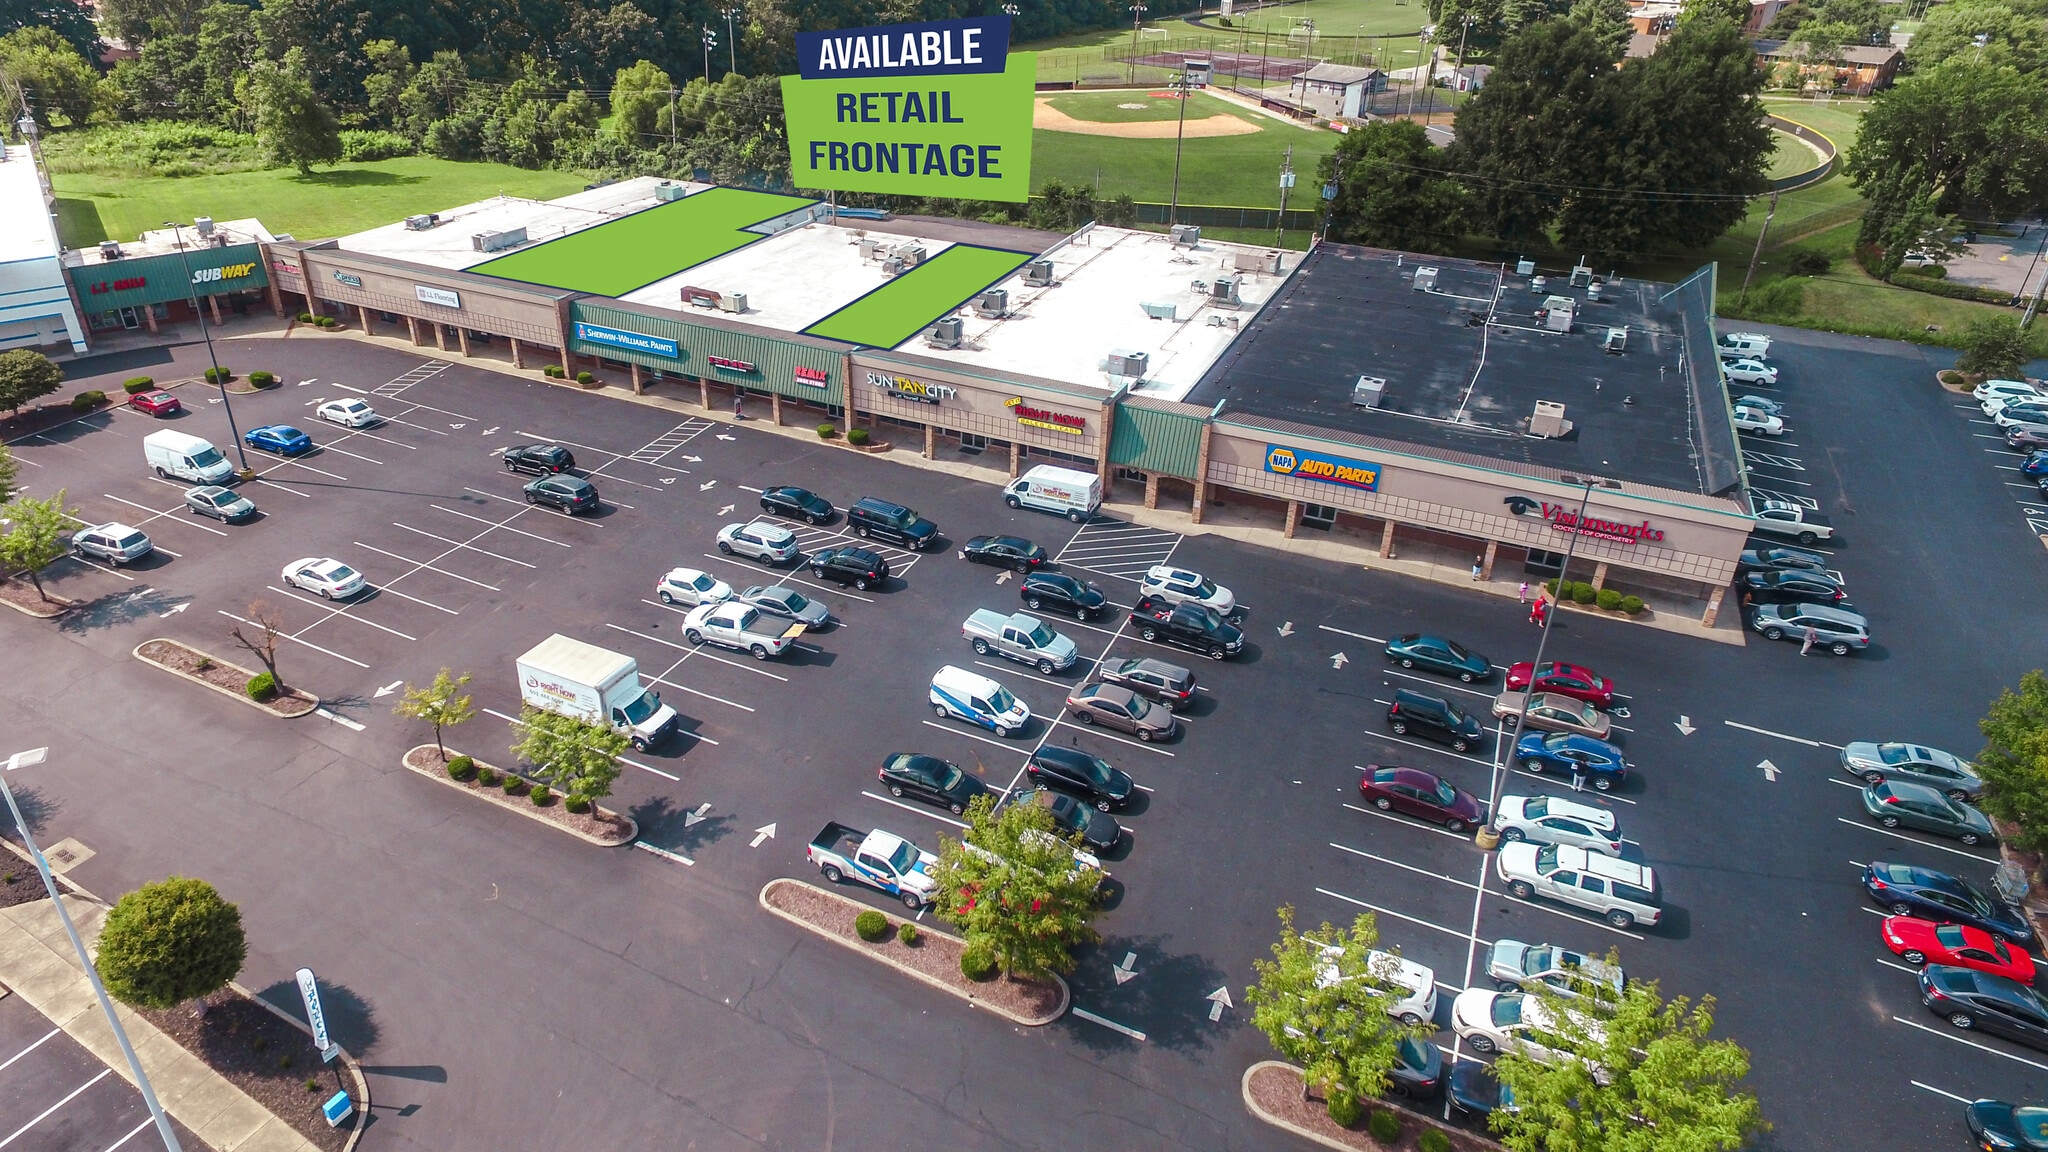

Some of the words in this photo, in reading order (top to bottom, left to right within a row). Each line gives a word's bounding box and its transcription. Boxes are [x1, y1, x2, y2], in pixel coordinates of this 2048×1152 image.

[191, 262, 256, 284] SUBWAY
[434, 293, 456, 304] Flooring
[650, 340, 673, 353] PAINTS
[795, 366, 827, 380] REMIX
[867, 372, 893, 389] SUN
[894, 376, 926, 395] TAN
[926, 383, 957, 400] CITY
[1015, 405, 1050, 421] RIGHT
[1053, 412, 1086, 428] NOW!
[1272, 455, 1292, 468] NAPA
[1299, 459, 1334, 476] AUTO
[1335, 466, 1376, 484] PARTS
[1541, 502, 1665, 541] Visionworks
[1552, 524, 1584, 535] DOCTOS
[1594, 532, 1634, 544] OPTOMETRY
[540, 682, 558, 693] RIGHT
[559, 689, 576, 699] NOW!
